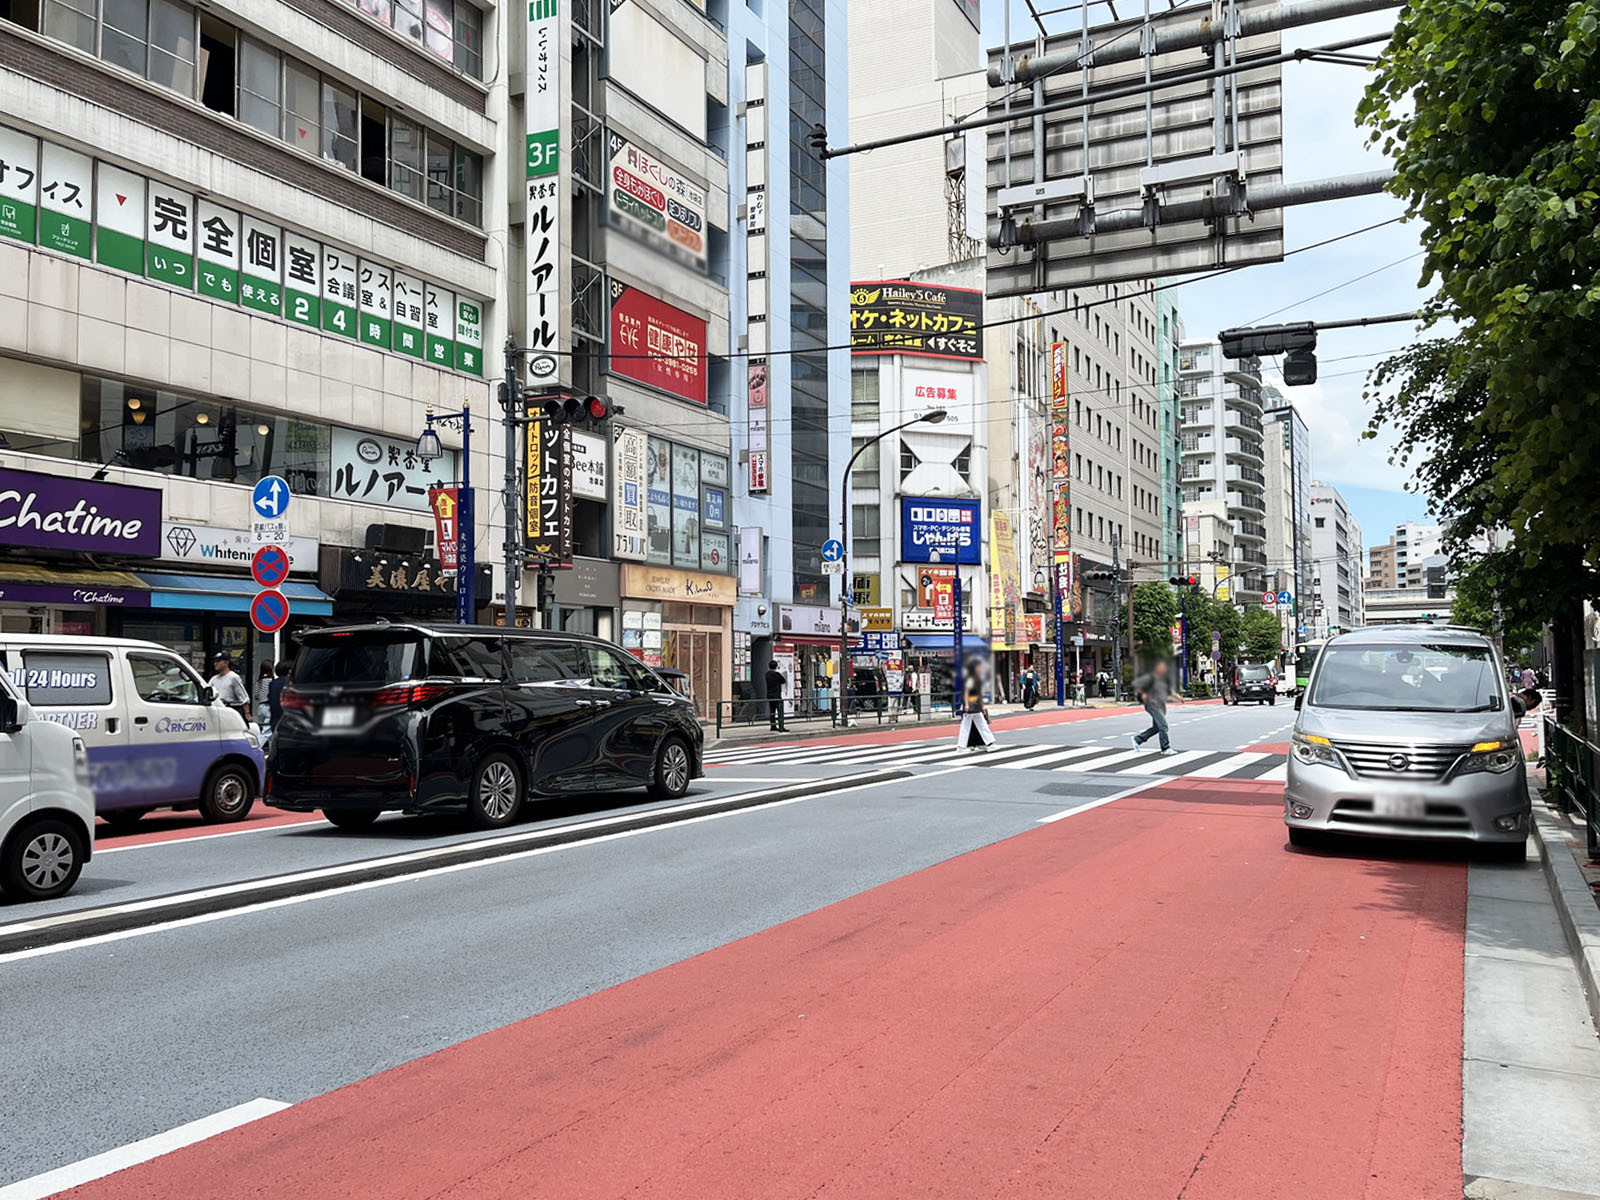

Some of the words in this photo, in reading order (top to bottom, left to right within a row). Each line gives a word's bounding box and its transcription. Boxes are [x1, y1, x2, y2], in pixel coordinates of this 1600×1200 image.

[538, 27, 548, 94] いいオフィス
[528, 142, 557, 167] 3F
[153, 197, 316, 285] 完全個室
[326, 253, 438, 308] ワークスペース
[531, 205, 556, 348] ルノアール
[611, 280, 623, 298] 3F
[327, 277, 439, 329] 会議室&自習室
[620, 324, 639, 349] EVE
[936, 337, 976, 353] すぐそこ
[914, 386, 957, 400] 広告募集
[541, 420, 559, 537] ットカフェ
[0, 489, 142, 540] Chatime
[529, 482, 539, 533] 防音個室
[257, 532, 262, 541] 8
[274, 532, 284, 541] 20
[913, 531, 971, 547] じゃんぱら
[83, 592, 124, 604] Chatime
[28, 669, 48, 687] 24
[50, 670, 96, 688] Hours
